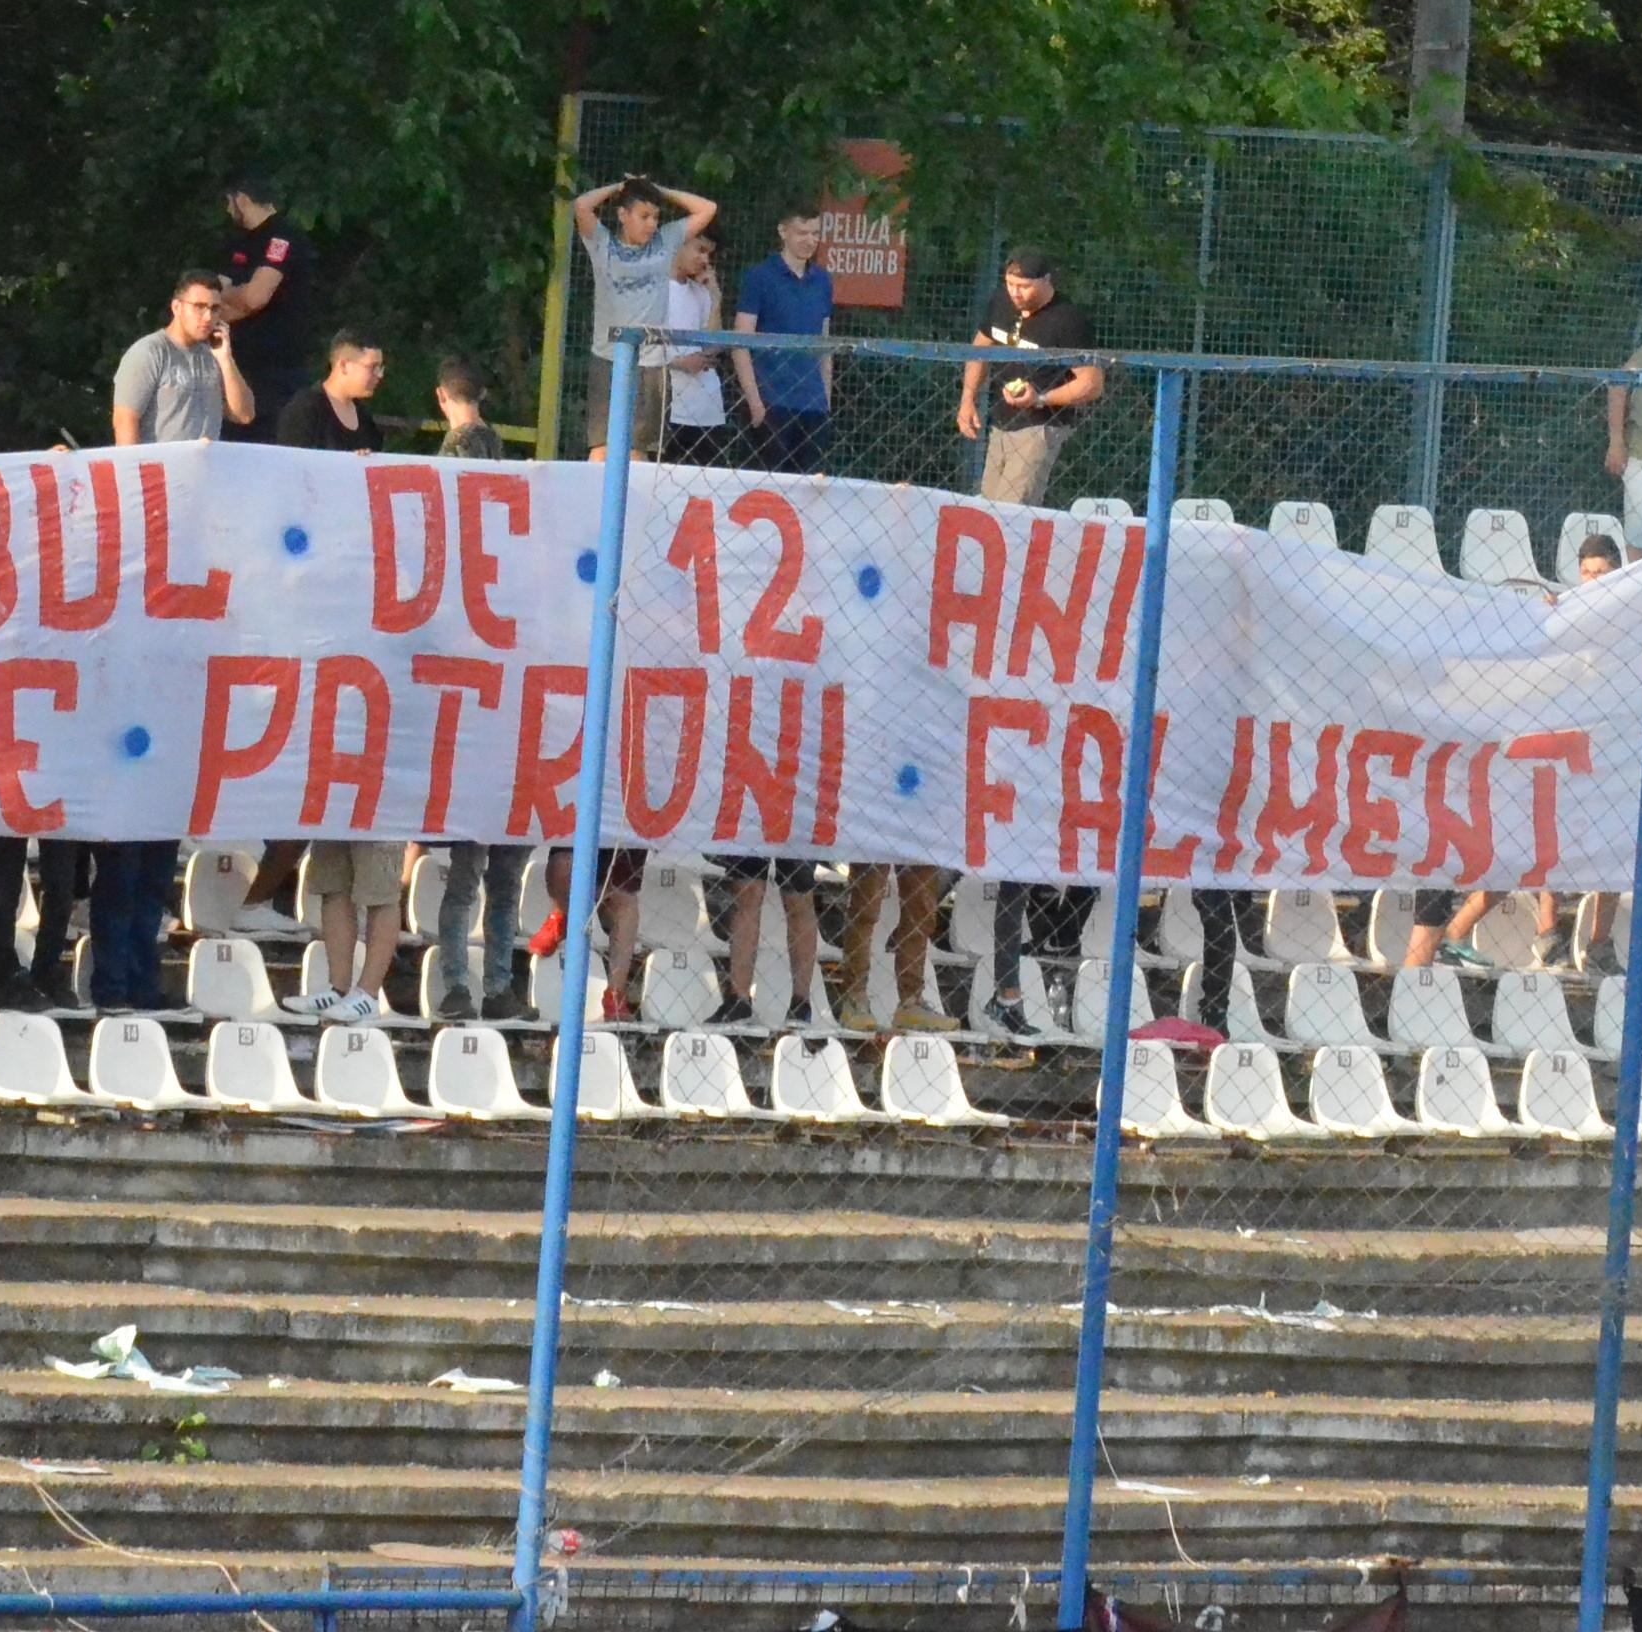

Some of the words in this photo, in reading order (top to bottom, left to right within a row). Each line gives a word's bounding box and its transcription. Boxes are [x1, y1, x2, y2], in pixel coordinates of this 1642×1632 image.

[821, 212, 891, 246] PELUZA
[826, 247, 885, 274] SECTOR
[887, 249, 899, 276] B
[366, 463, 529, 650] DE
[666, 489, 824, 664] 12
[927, 504, 1146, 685] ANI
[188, 654, 845, 847] PATRONI
[964, 695, 1593, 887] FALIMENT
